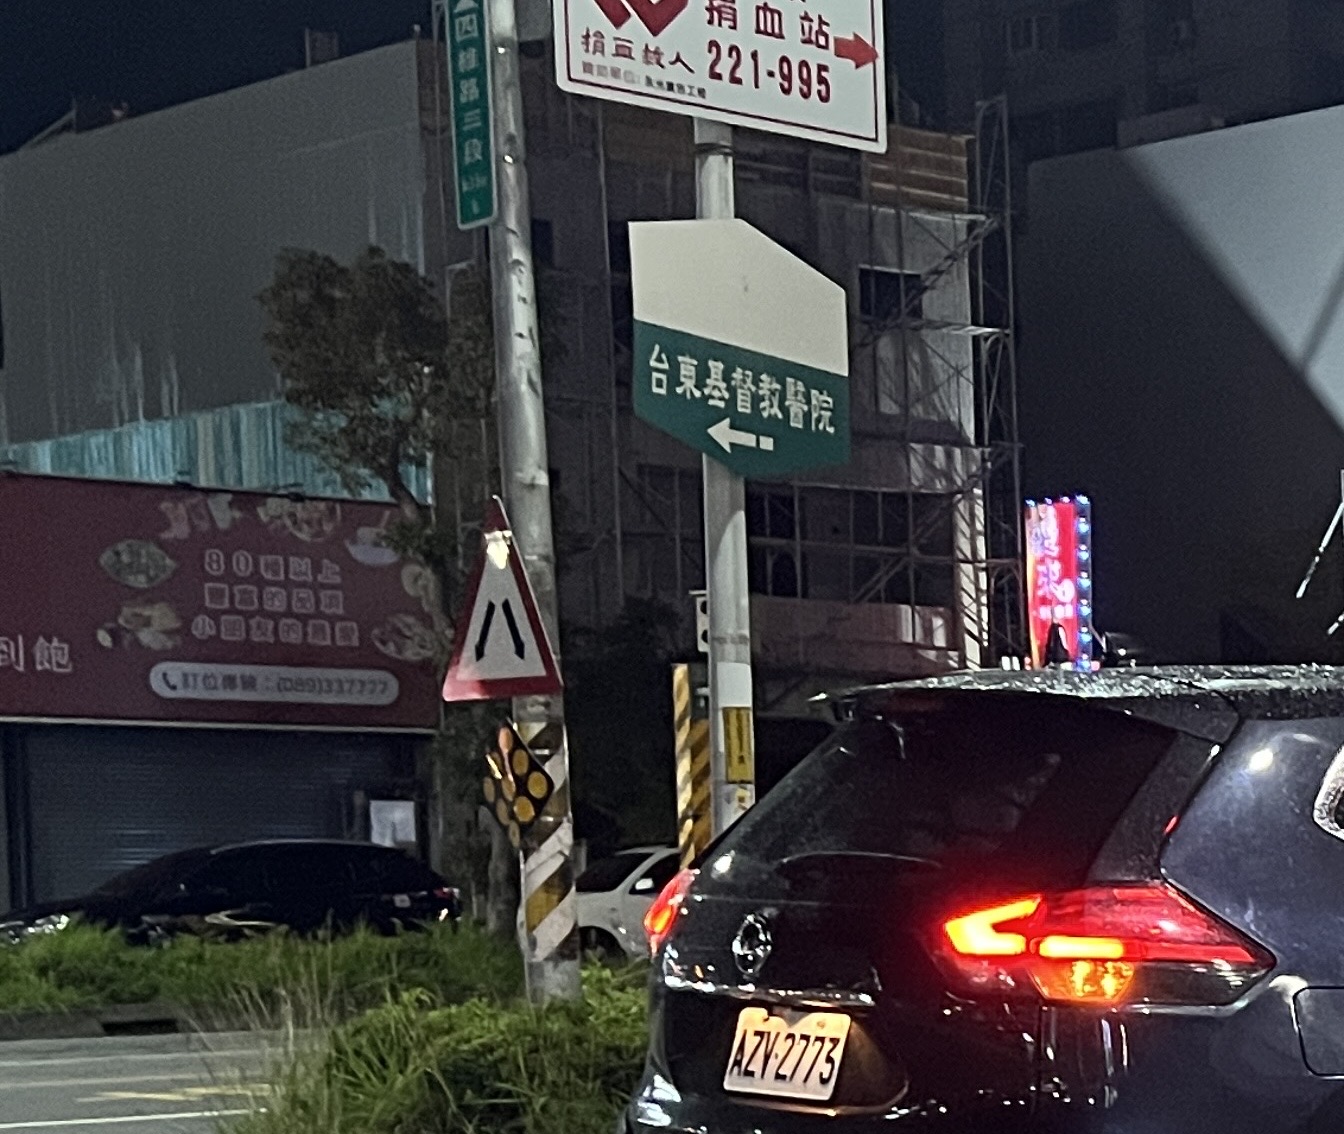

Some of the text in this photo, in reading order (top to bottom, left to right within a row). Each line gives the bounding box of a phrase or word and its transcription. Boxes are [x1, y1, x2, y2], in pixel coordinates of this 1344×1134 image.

[705, 0, 831, 50] 捐血站
[707, 39, 831, 103] 221-995
[649, 343, 836, 434] 台東基督教醫院
